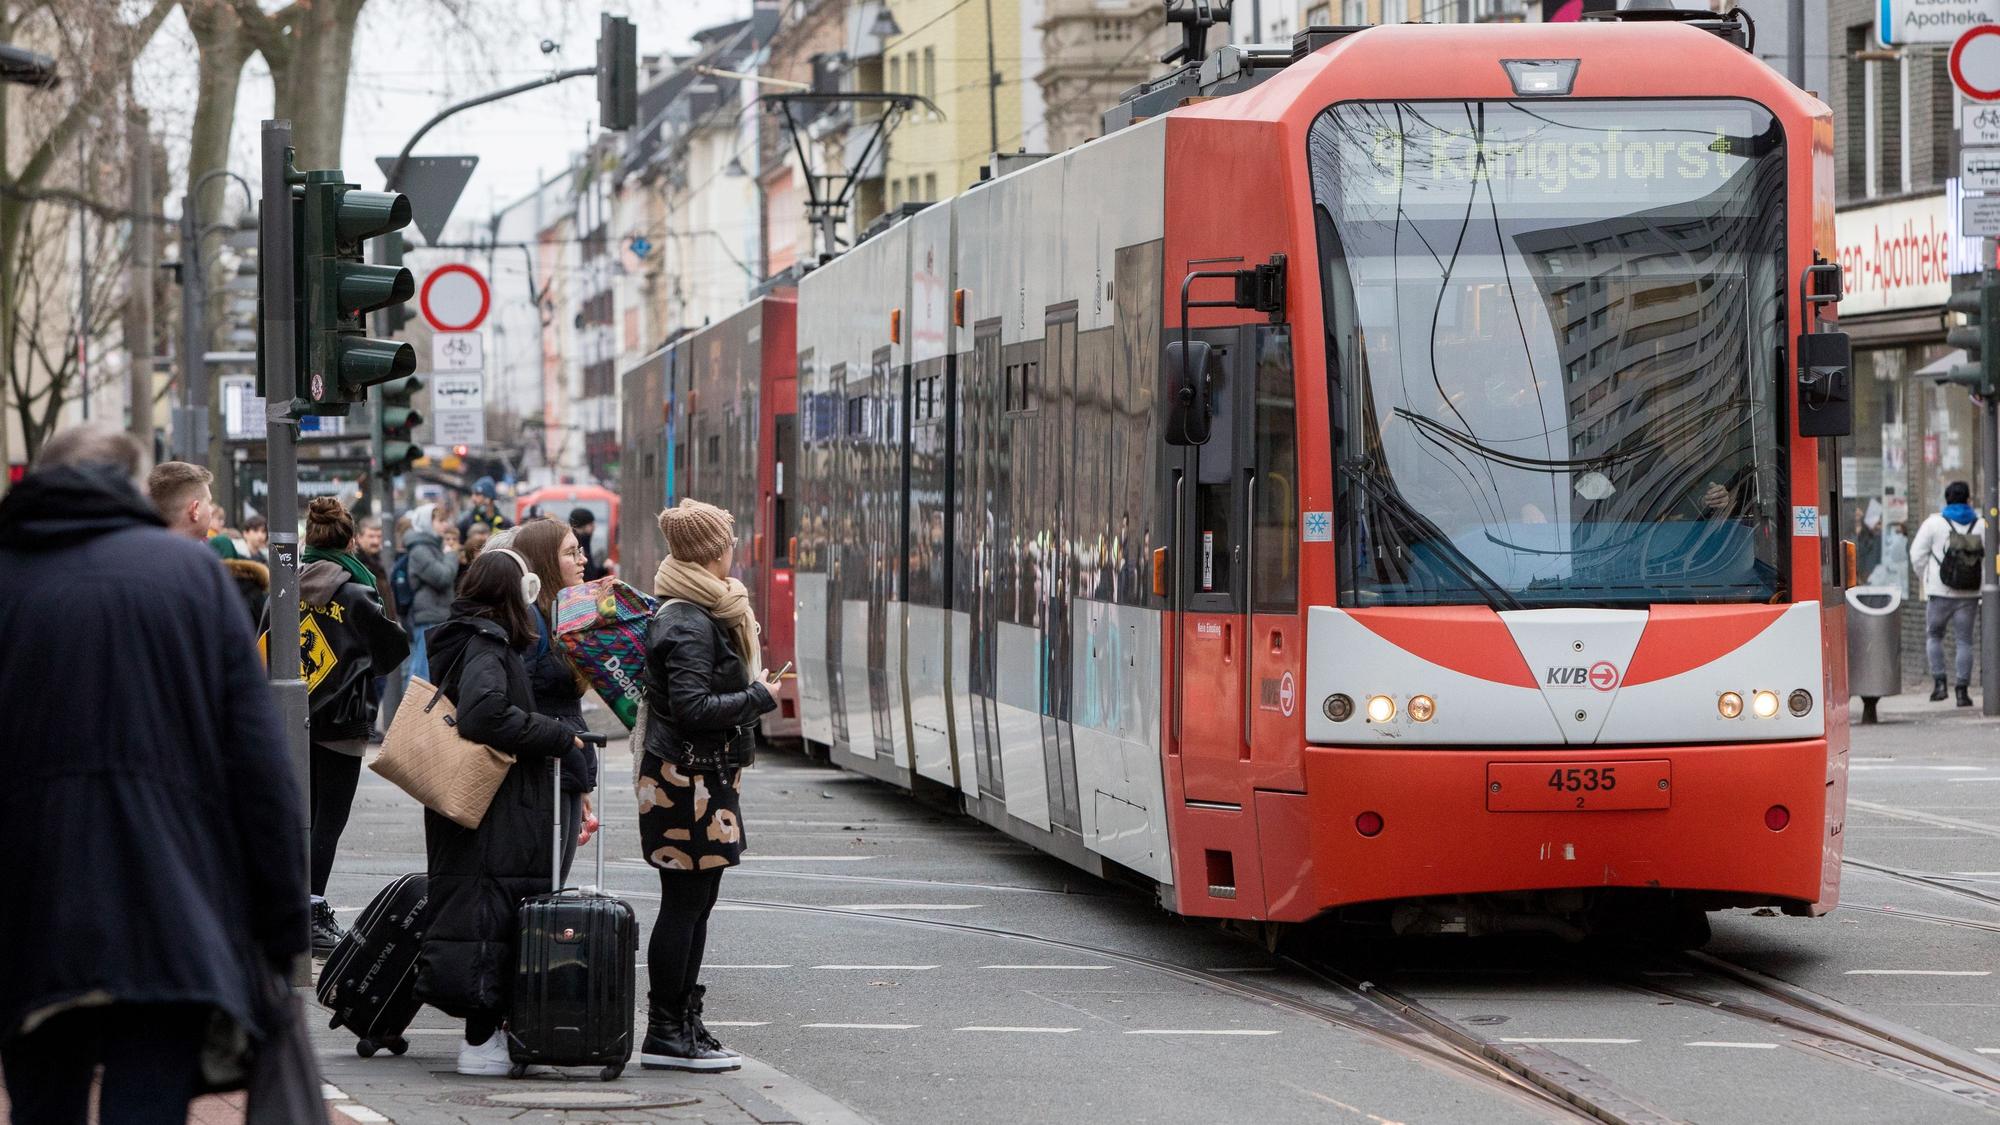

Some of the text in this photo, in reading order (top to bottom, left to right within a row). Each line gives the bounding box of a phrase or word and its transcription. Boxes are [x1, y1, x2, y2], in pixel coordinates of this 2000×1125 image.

[1905, 10, 1986, 29] Apotheke
[1981, 131, 1999, 140] frei
[1981, 176, 1999, 185] frei
[1836, 214, 1949, 305] en-Apotheke
[603, 655, 644, 705] Desigu
[1546, 667, 1588, 684] KVB
[1548, 768, 1616, 792] 4535
[1576, 797, 1585, 808] 2
[402, 894, 429, 929] VELLER
[357, 942, 396, 994] TRAVELLER
